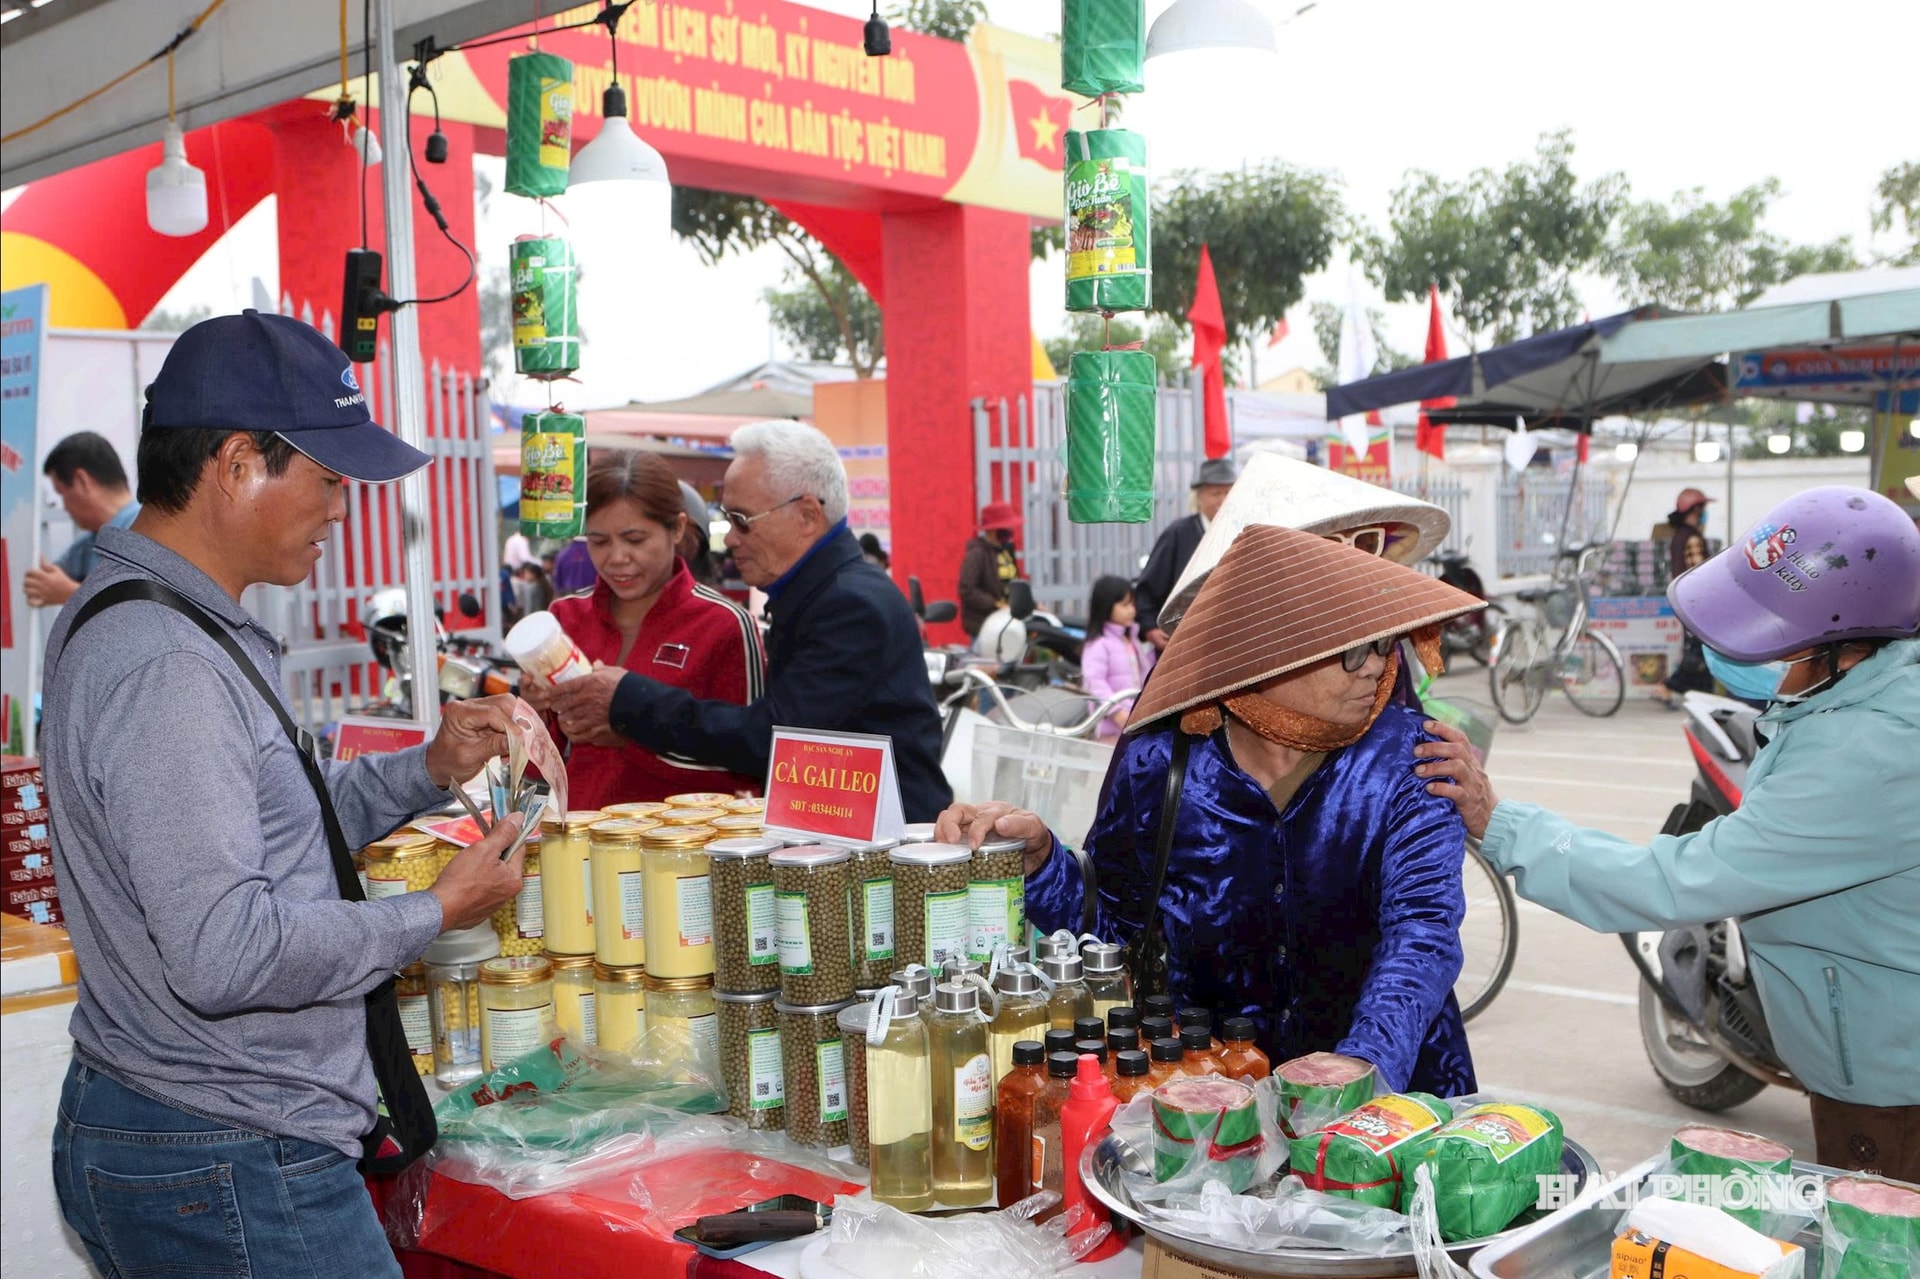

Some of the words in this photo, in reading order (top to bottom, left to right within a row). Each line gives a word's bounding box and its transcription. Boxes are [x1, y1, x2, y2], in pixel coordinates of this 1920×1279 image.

[662, 3, 707, 63] LỊCH
[635, 76, 691, 133] VƯƠN
[694, 81, 747, 143] MÌNH
[750, 82, 789, 151] CỦA
[790, 100, 829, 157] DÂN
[831, 108, 864, 171] TỘC
[865, 116, 901, 178] VIỆT
[1775, 566, 1807, 592] kitty
[1786, 550, 1820, 580] Hello
[775, 757, 798, 784] CÀ
[803, 765, 836, 789] GAI
[839, 769, 877, 794] LEO
[1616, 1252, 1644, 1265] sipiao
